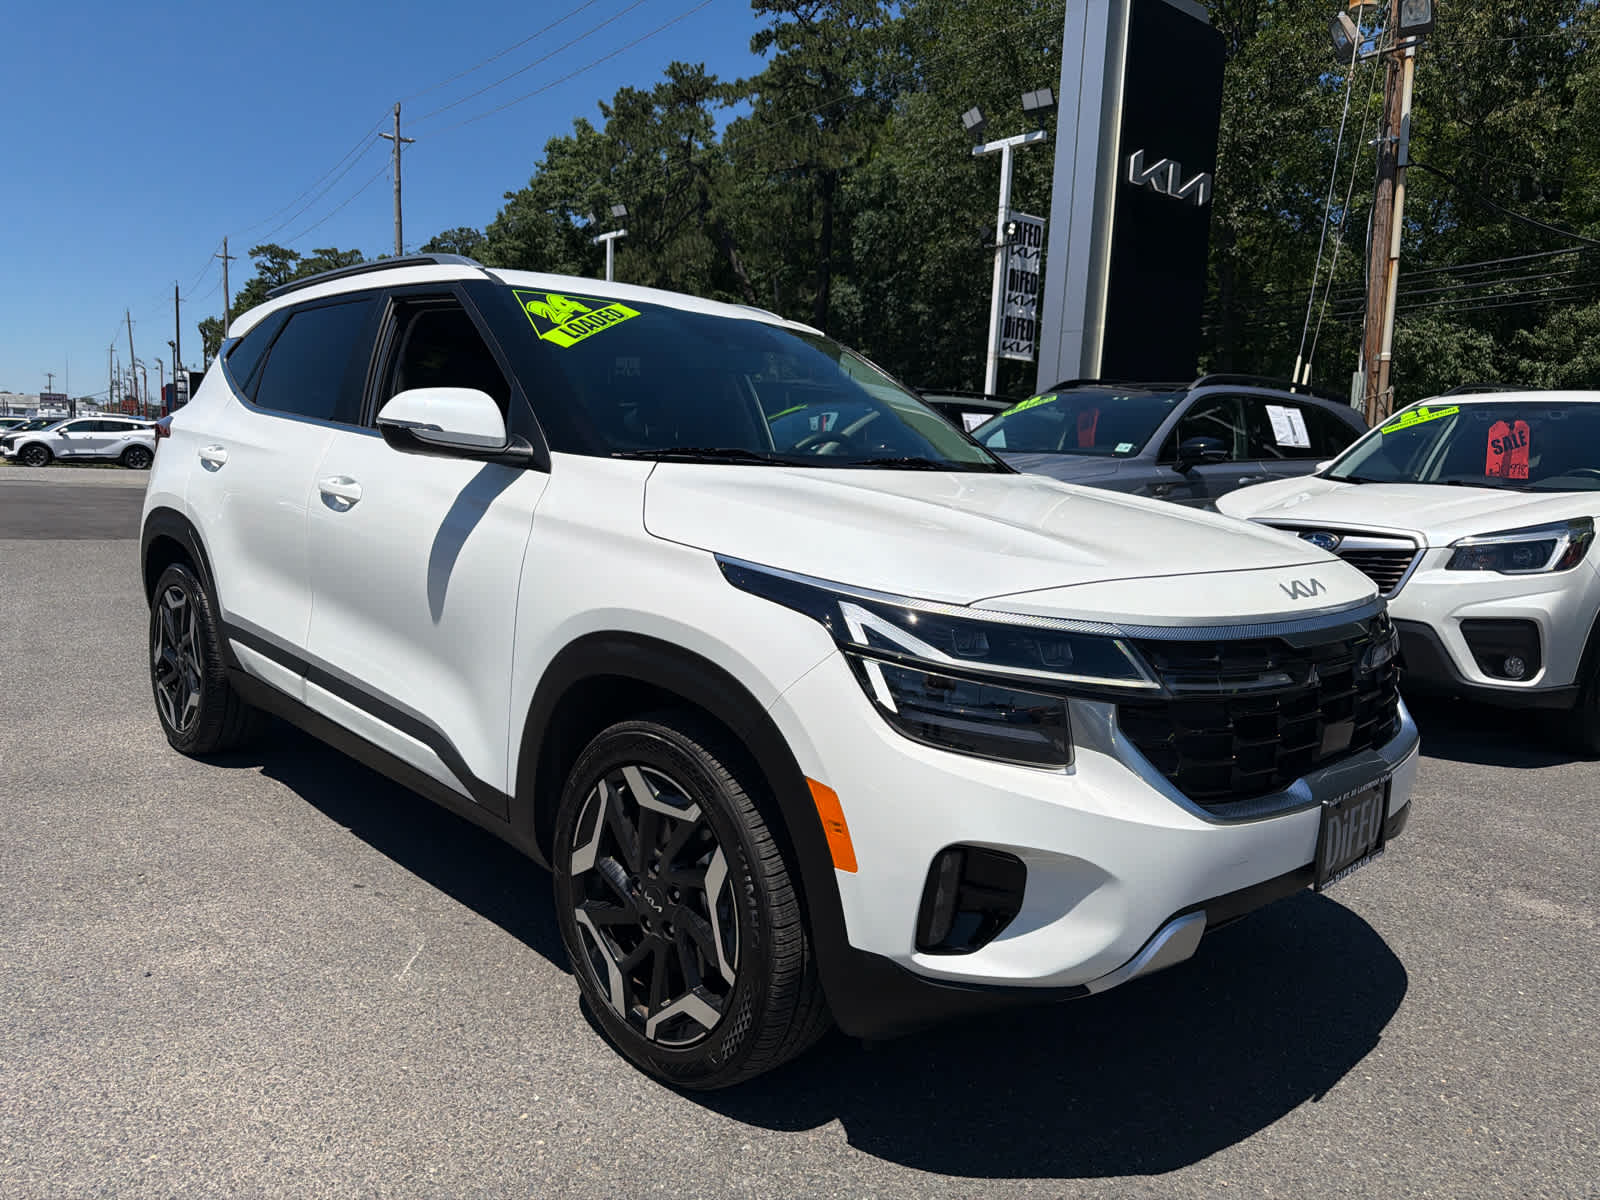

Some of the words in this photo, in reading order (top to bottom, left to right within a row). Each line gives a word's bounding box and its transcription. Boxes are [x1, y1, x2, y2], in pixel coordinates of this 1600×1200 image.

[1128, 149, 1212, 206] KIA
[1010, 246, 1041, 259] KIA
[526, 293, 592, 325] 24
[1007, 292, 1036, 307] KIA
[559, 307, 625, 340] LOADED
[1002, 341, 1033, 354] KIA
[1491, 430, 1527, 455] SALE
